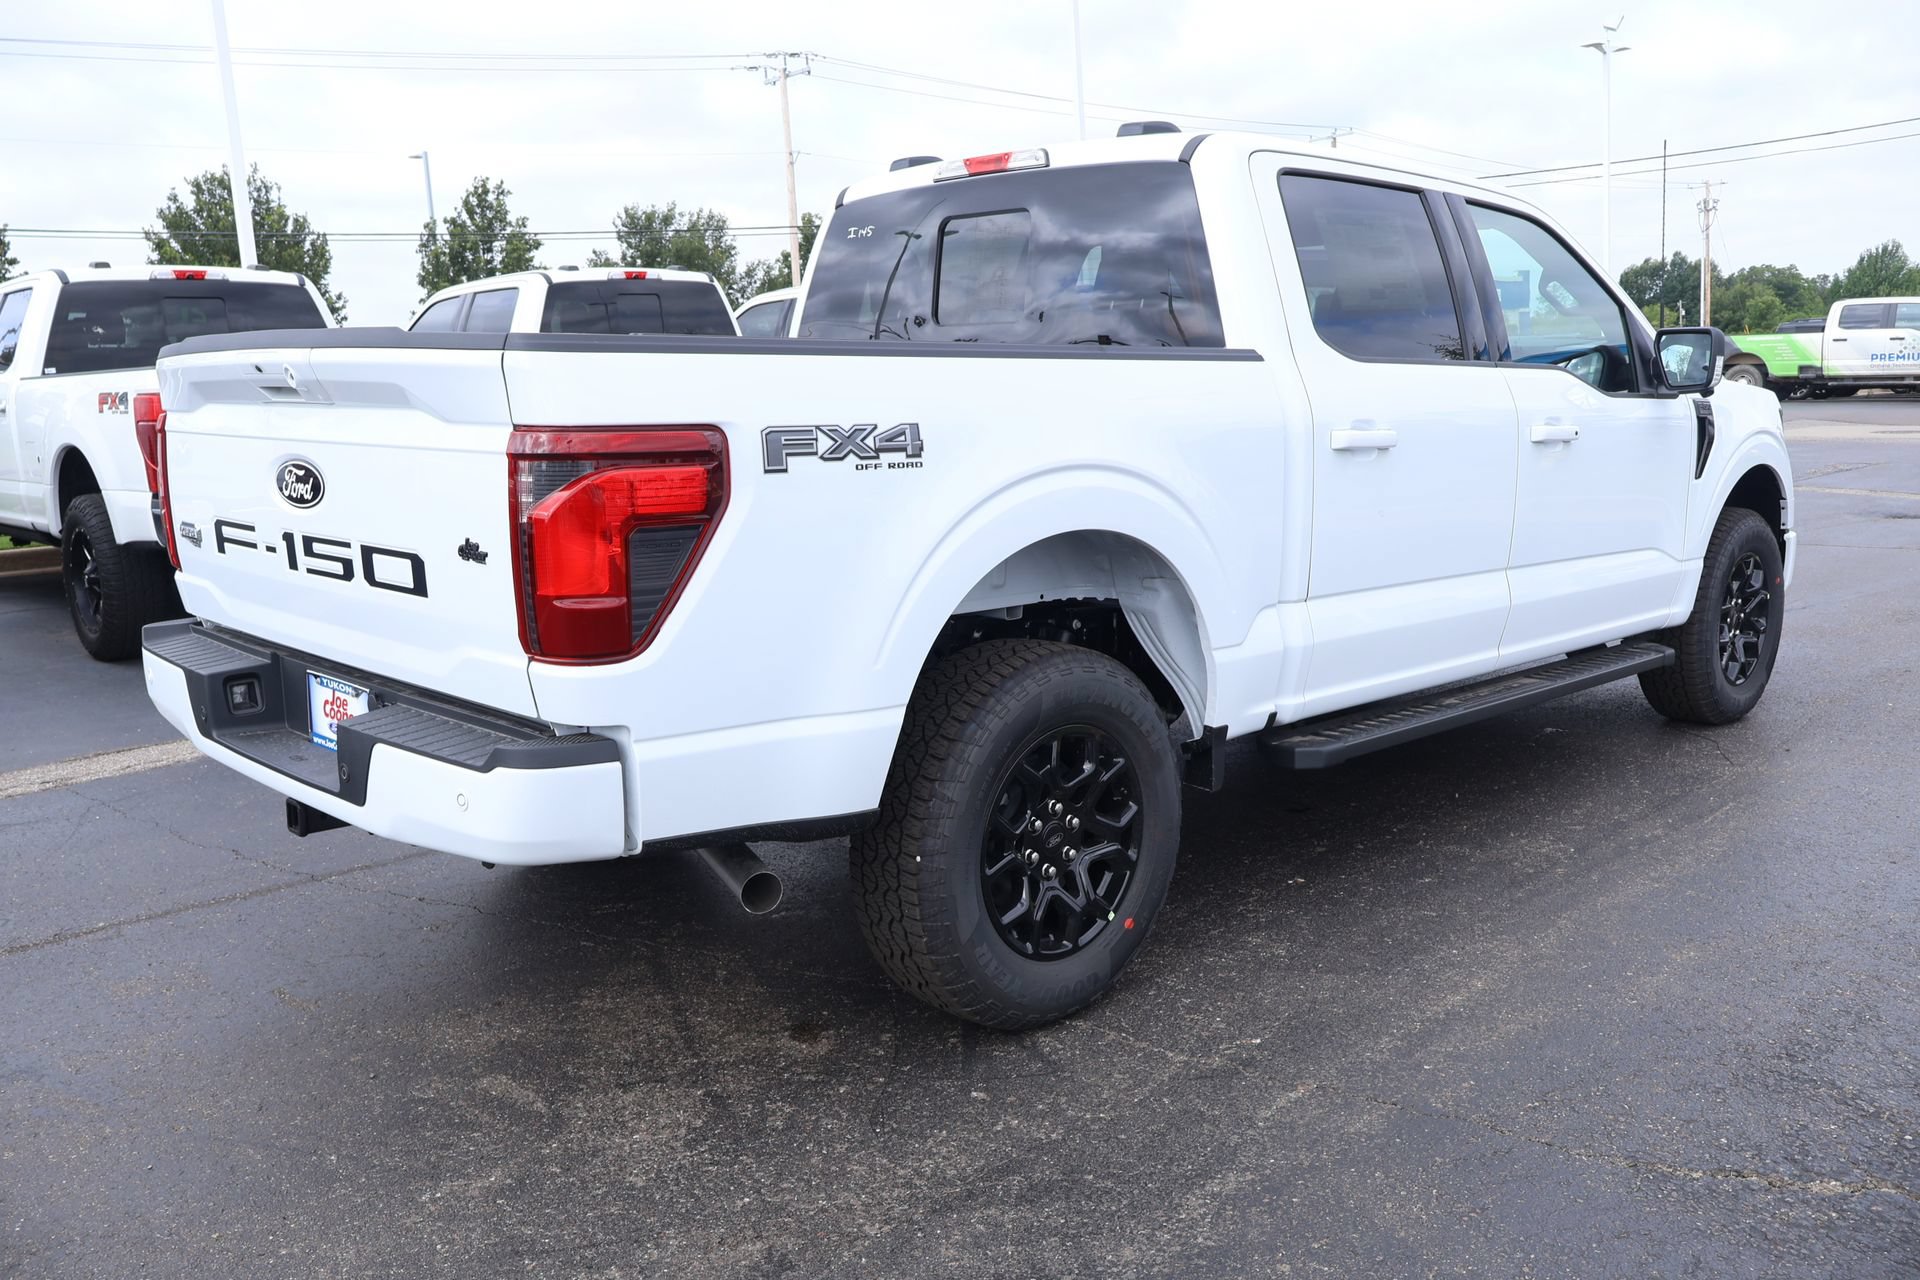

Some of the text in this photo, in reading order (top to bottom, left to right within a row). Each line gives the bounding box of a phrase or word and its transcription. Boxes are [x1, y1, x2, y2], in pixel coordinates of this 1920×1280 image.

[98, 391, 129, 414] FX4
[761, 423, 924, 474] FX4
[855, 461, 923, 471] OFF ROAD
[282, 466, 314, 500] Ford
[213, 518, 429, 599] F-150
[321, 677, 353, 694] YUKON
[330, 688, 348, 711] Joe
